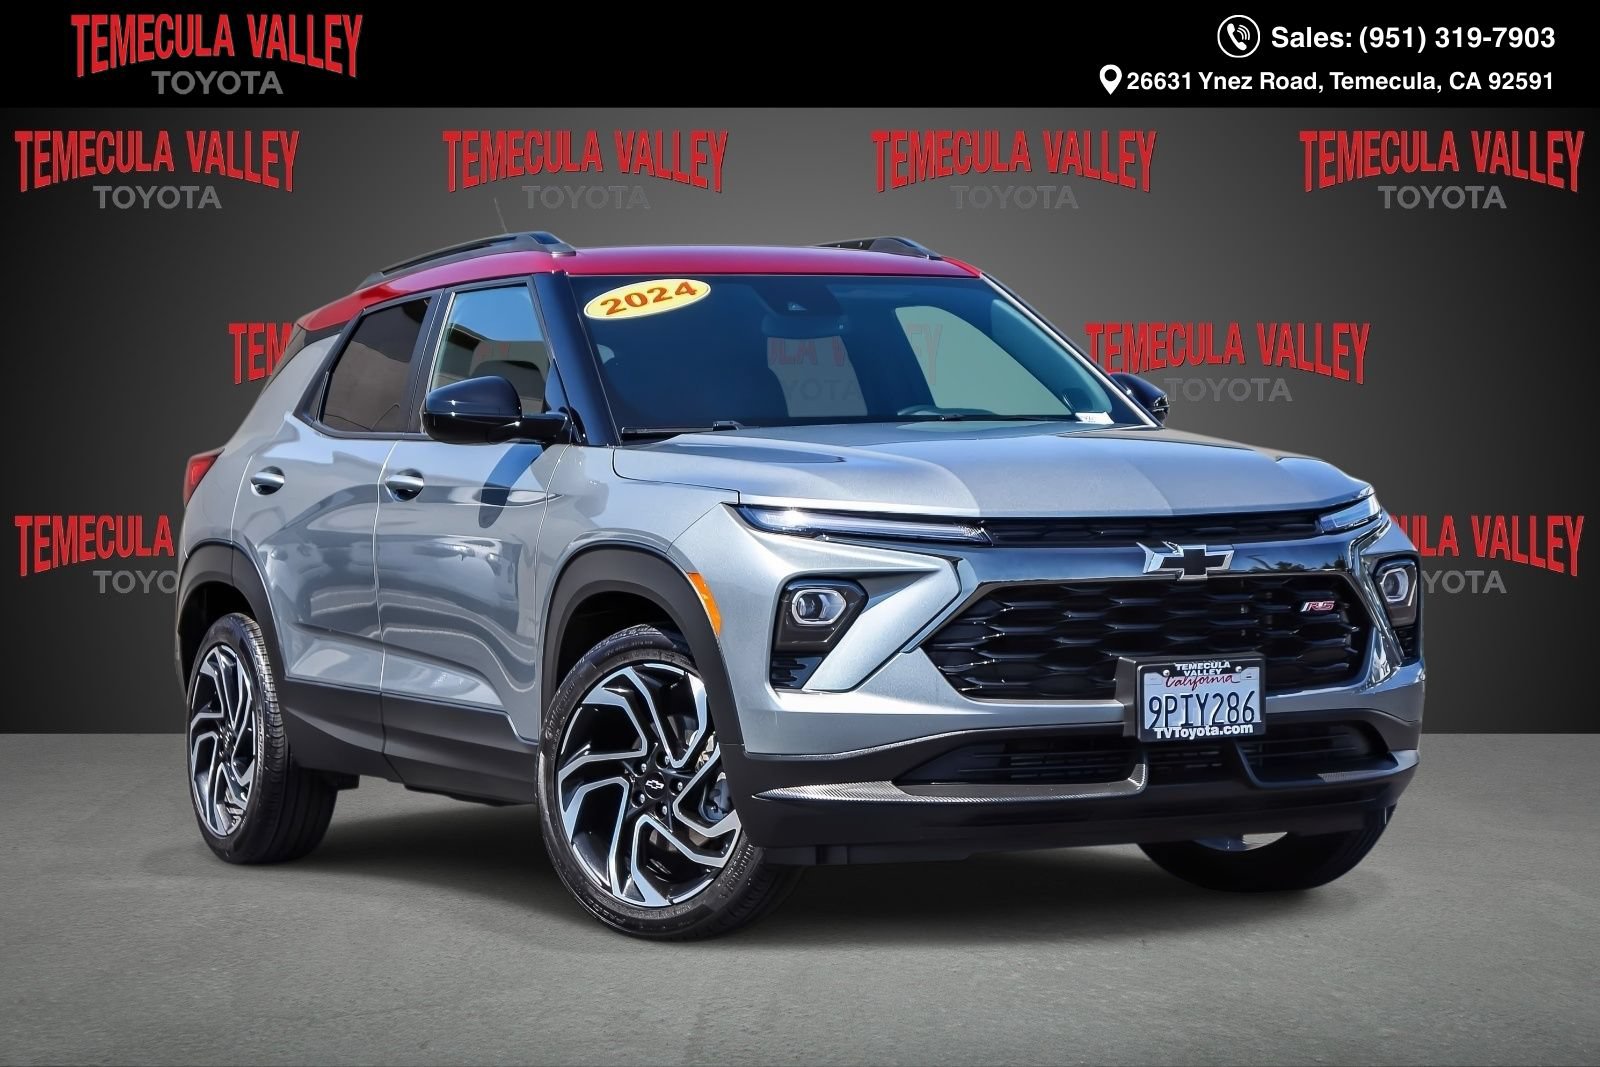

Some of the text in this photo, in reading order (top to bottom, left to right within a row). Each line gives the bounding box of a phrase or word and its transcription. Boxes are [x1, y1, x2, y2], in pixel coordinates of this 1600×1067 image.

[600, 281, 697, 316] 2024
[1175, 661, 1231, 671] TEMECULA
[1184, 669, 1222, 677] VALLEY
[1165, 674, 1240, 691] California
[1148, 690, 1256, 730] 9PIY286
[1154, 723, 1254, 740] TVToyota.com
